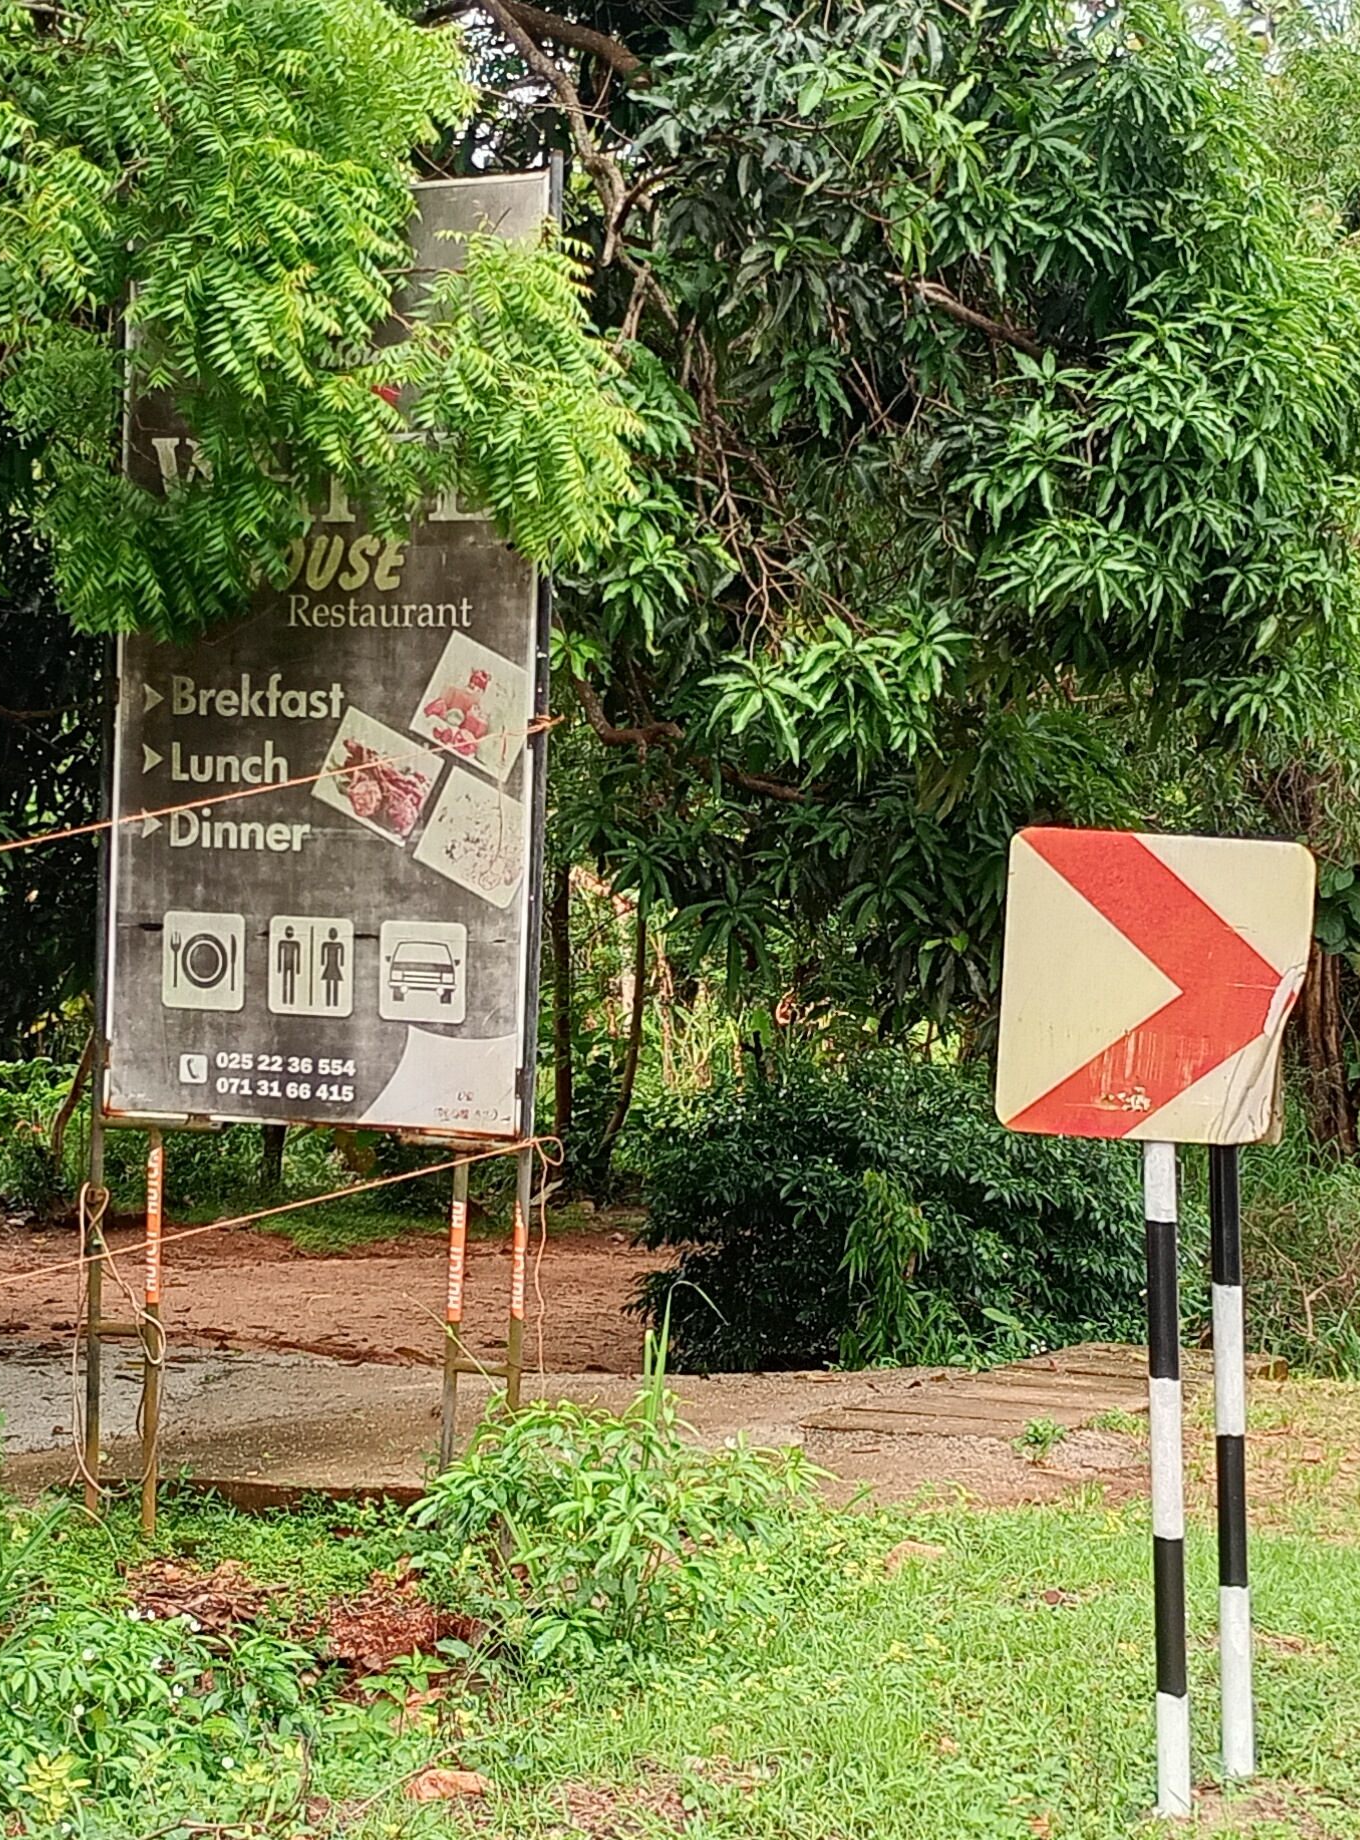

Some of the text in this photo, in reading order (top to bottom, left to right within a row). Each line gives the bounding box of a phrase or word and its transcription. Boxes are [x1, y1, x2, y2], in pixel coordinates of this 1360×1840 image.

[289, 594, 473, 628] Restaurant
[172, 673, 345, 719] Brekfast
[171, 740, 288, 784] Lunch
[170, 807, 311, 852] Dinner
[216, 1052, 356, 1077] 025 22 36 554
[216, 1078, 354, 1102] 071 31 66 415
